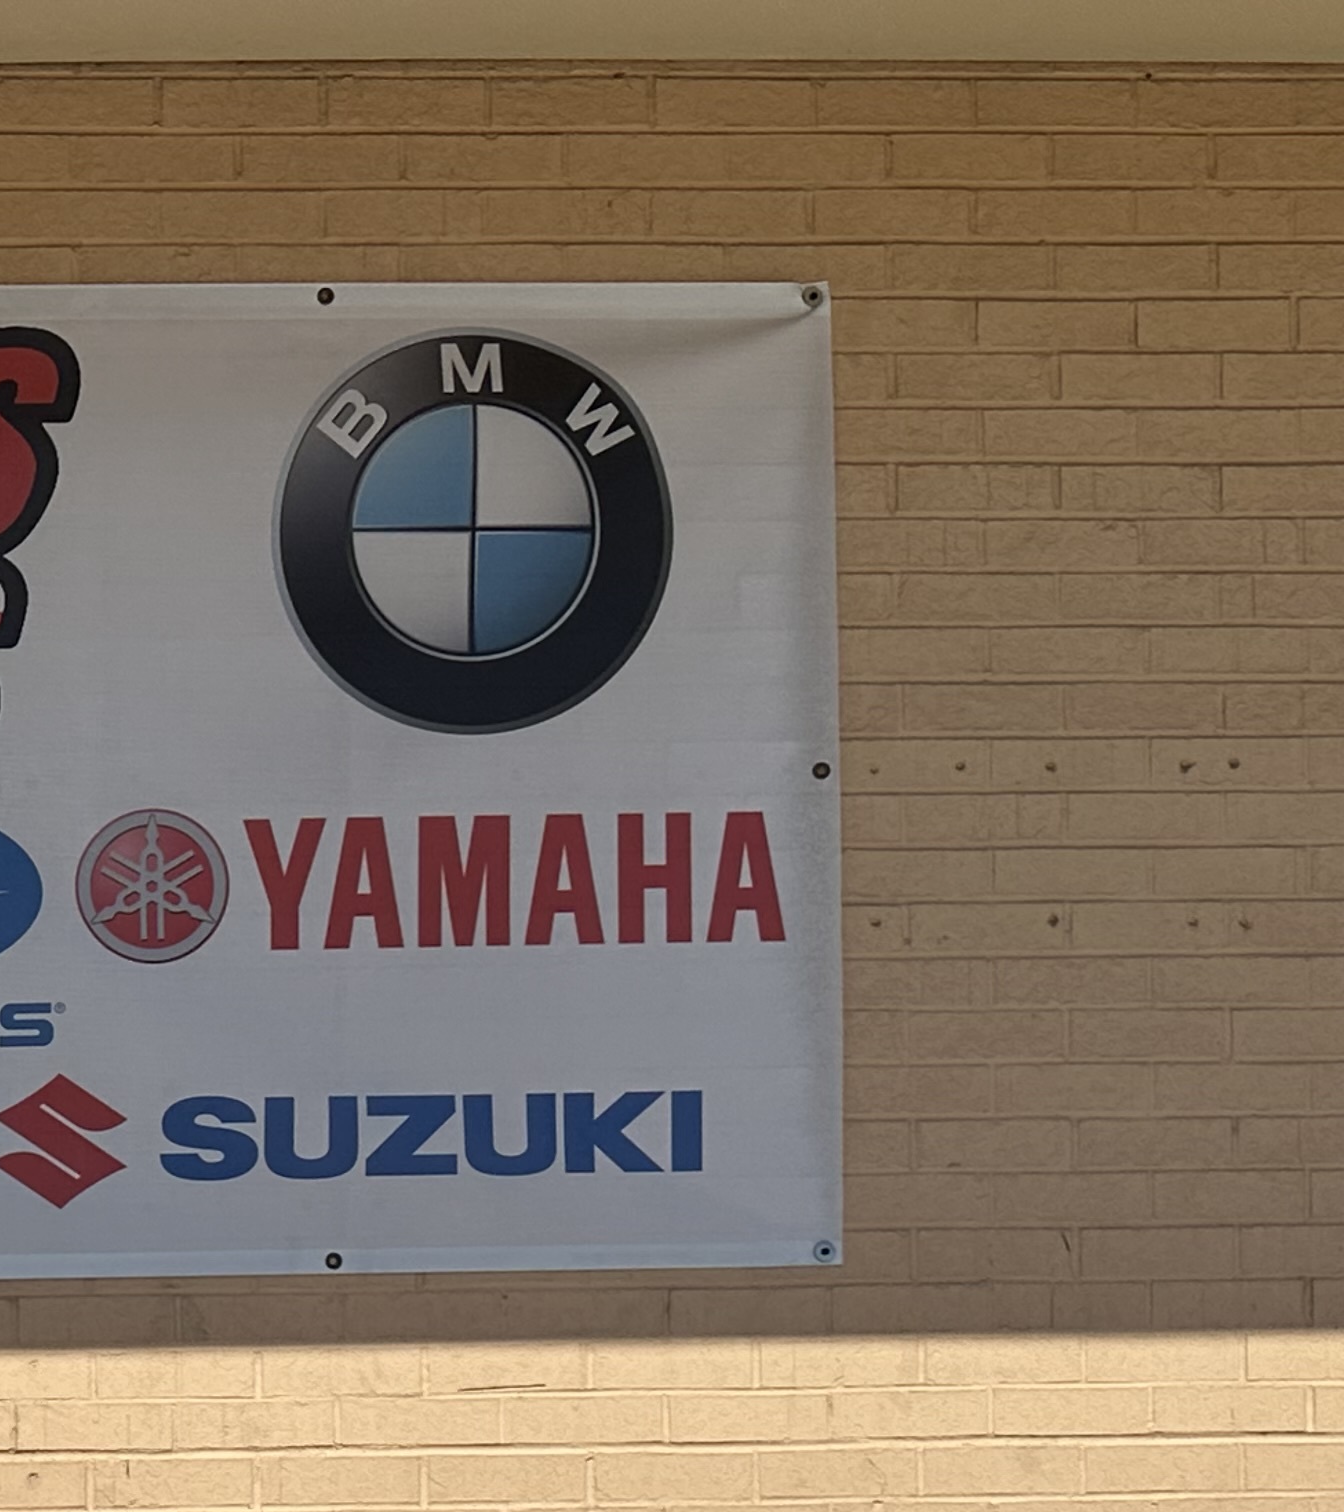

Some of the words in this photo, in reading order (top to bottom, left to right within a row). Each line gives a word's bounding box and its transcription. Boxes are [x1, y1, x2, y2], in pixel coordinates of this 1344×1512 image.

[317, 342, 636, 459] BMW
[243, 810, 788, 951] YAMAHA
[158, 1089, 704, 1181] SUZUKI
